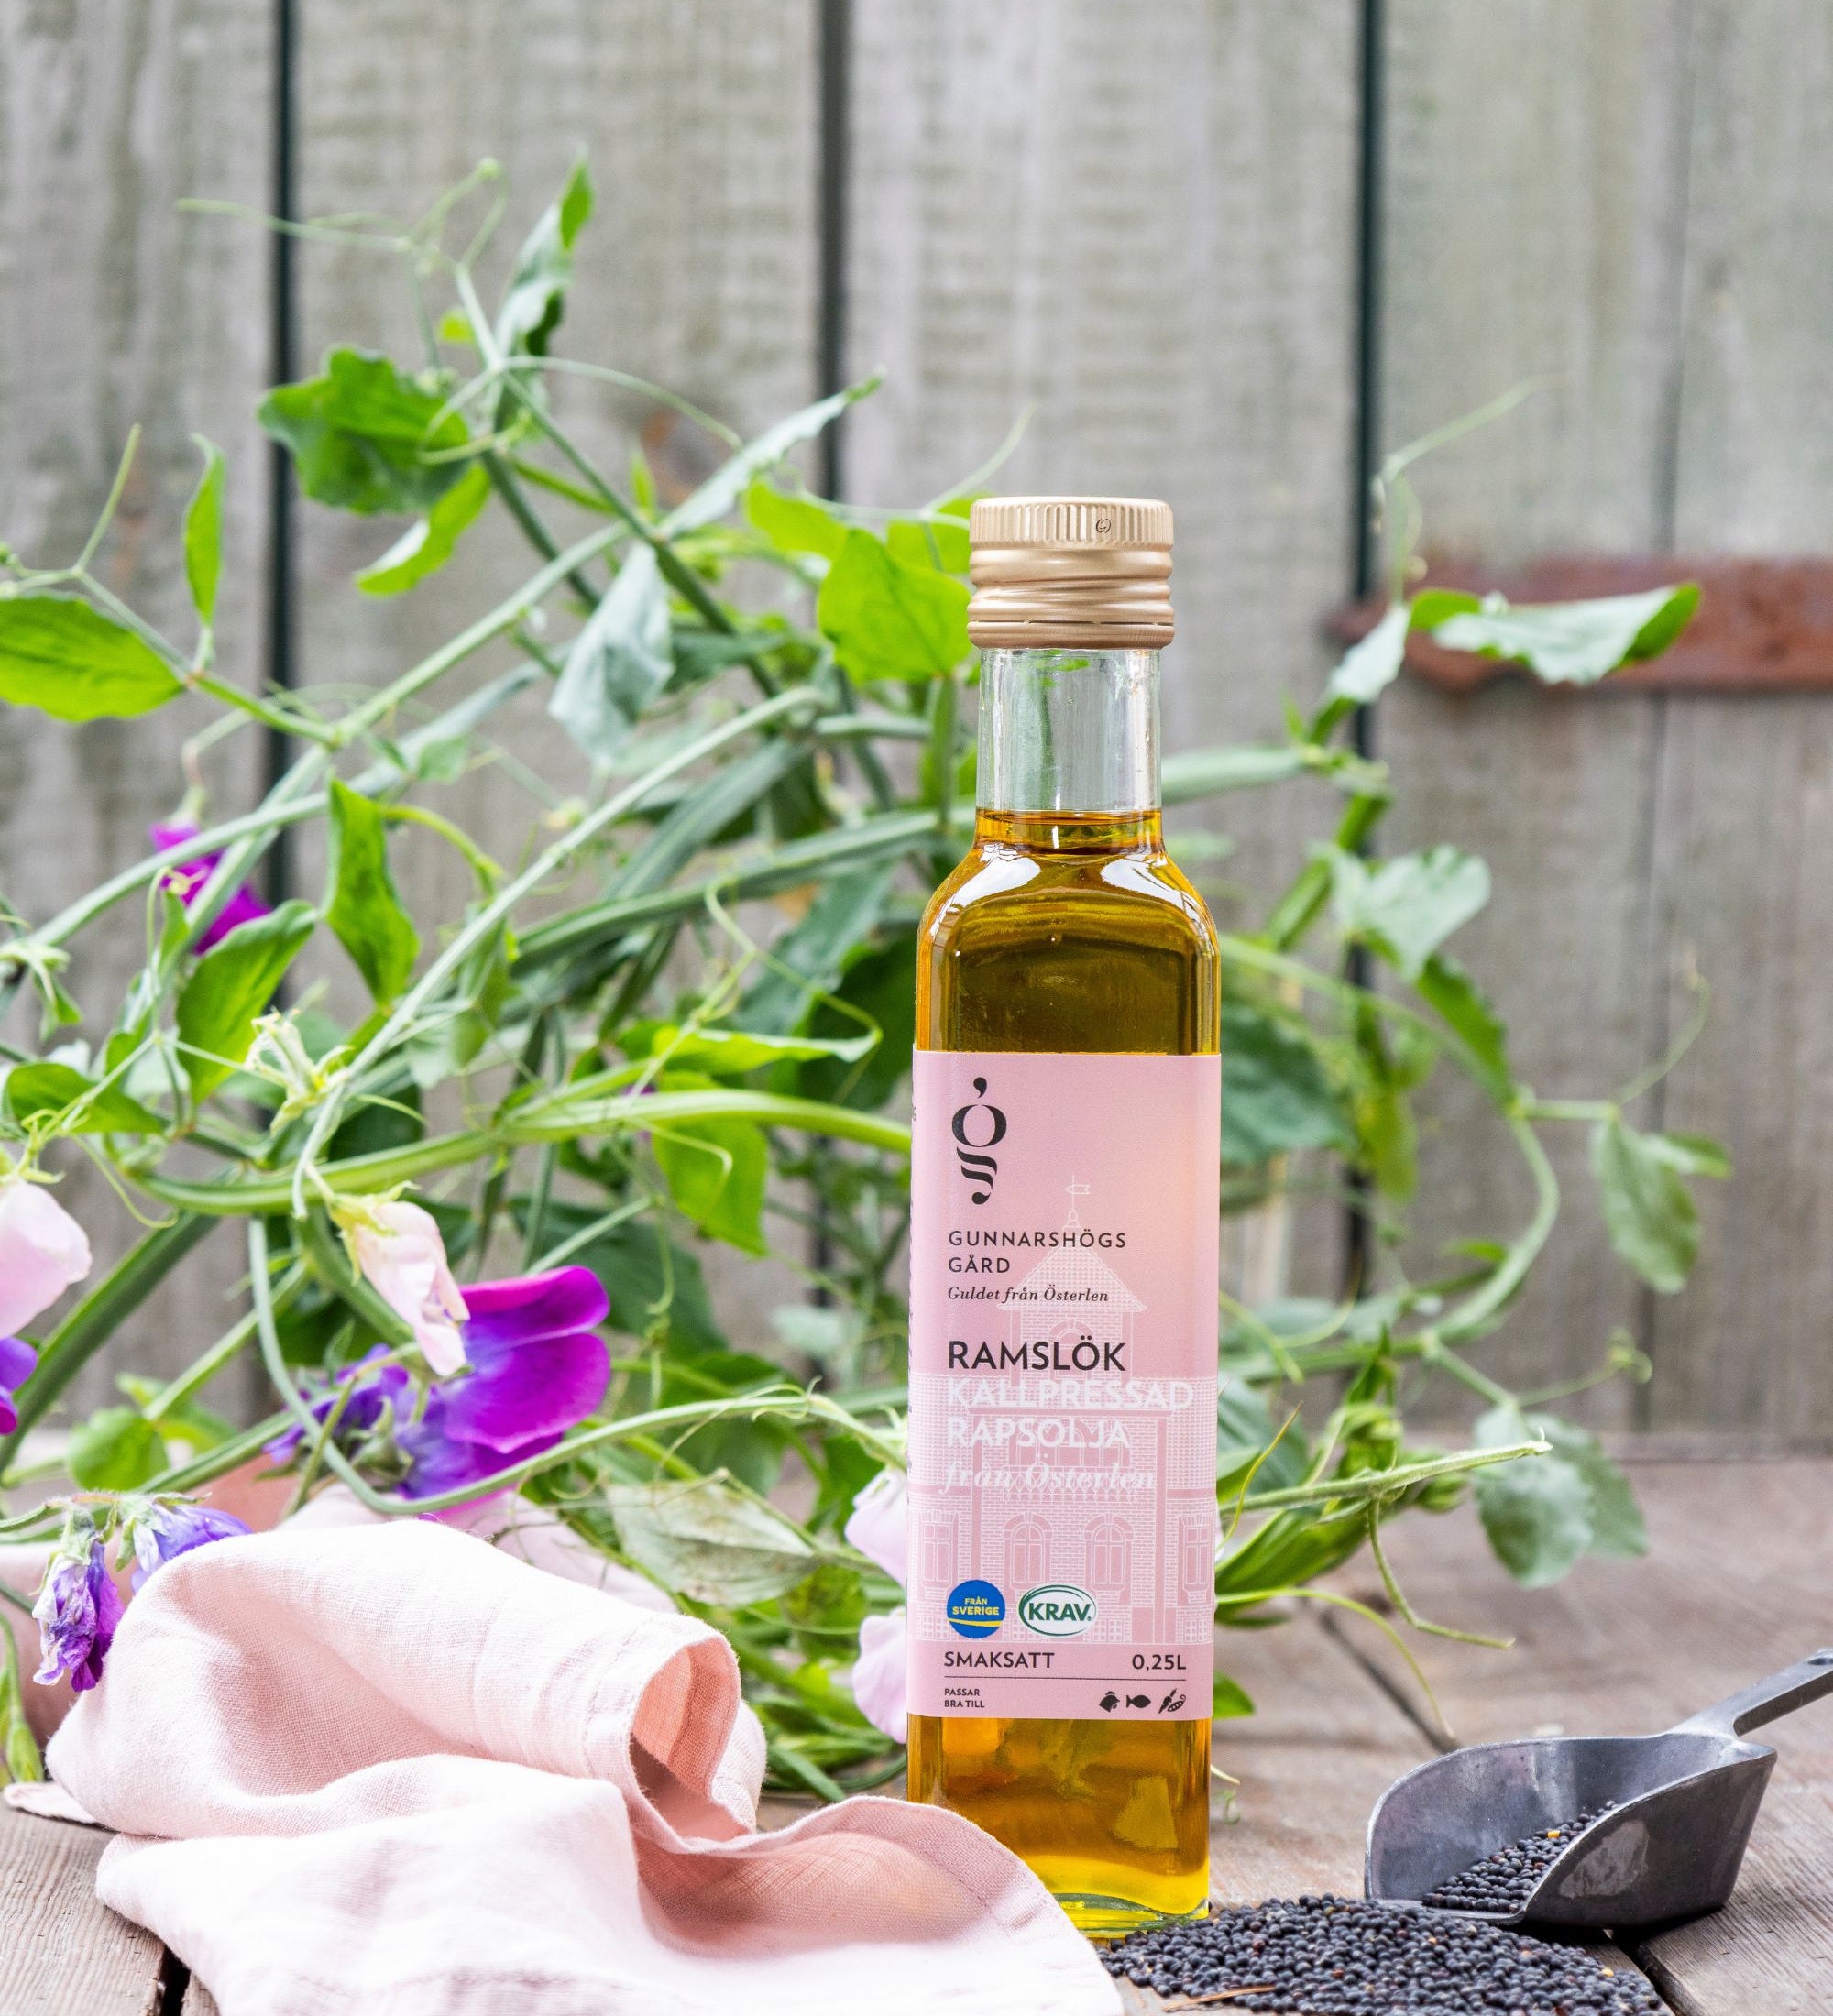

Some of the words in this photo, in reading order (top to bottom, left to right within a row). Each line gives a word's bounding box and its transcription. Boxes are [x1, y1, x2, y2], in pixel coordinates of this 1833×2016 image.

[949, 1229, 1126, 1248] GUNNARSHÖGS
[948, 1254, 1010, 1274] GÅRD
[948, 1286, 1000, 1300] Guldet
[1002, 1287, 1038, 1304] från
[1043, 1284, 1109, 1302] Österlen
[949, 1335, 1126, 1371] RAMSLÖK
[947, 1378, 1193, 1410] KALLPRESSAD
[946, 1417, 1131, 1449] RAPSOLJA
[938, 1462, 1013, 1495] från
[1025, 1452, 1156, 1490] Österlen
[964, 1595, 988, 1605] FRÅN
[952, 1605, 1000, 1616] SVERIGE
[944, 1651, 1055, 1669] SMAKSATT
[1132, 1654, 1187, 1672] 0,25L
[944, 1688, 981, 1697] PASSAR
[944, 1699, 965, 1708] BRA
[965, 1700, 985, 1708] TILL
